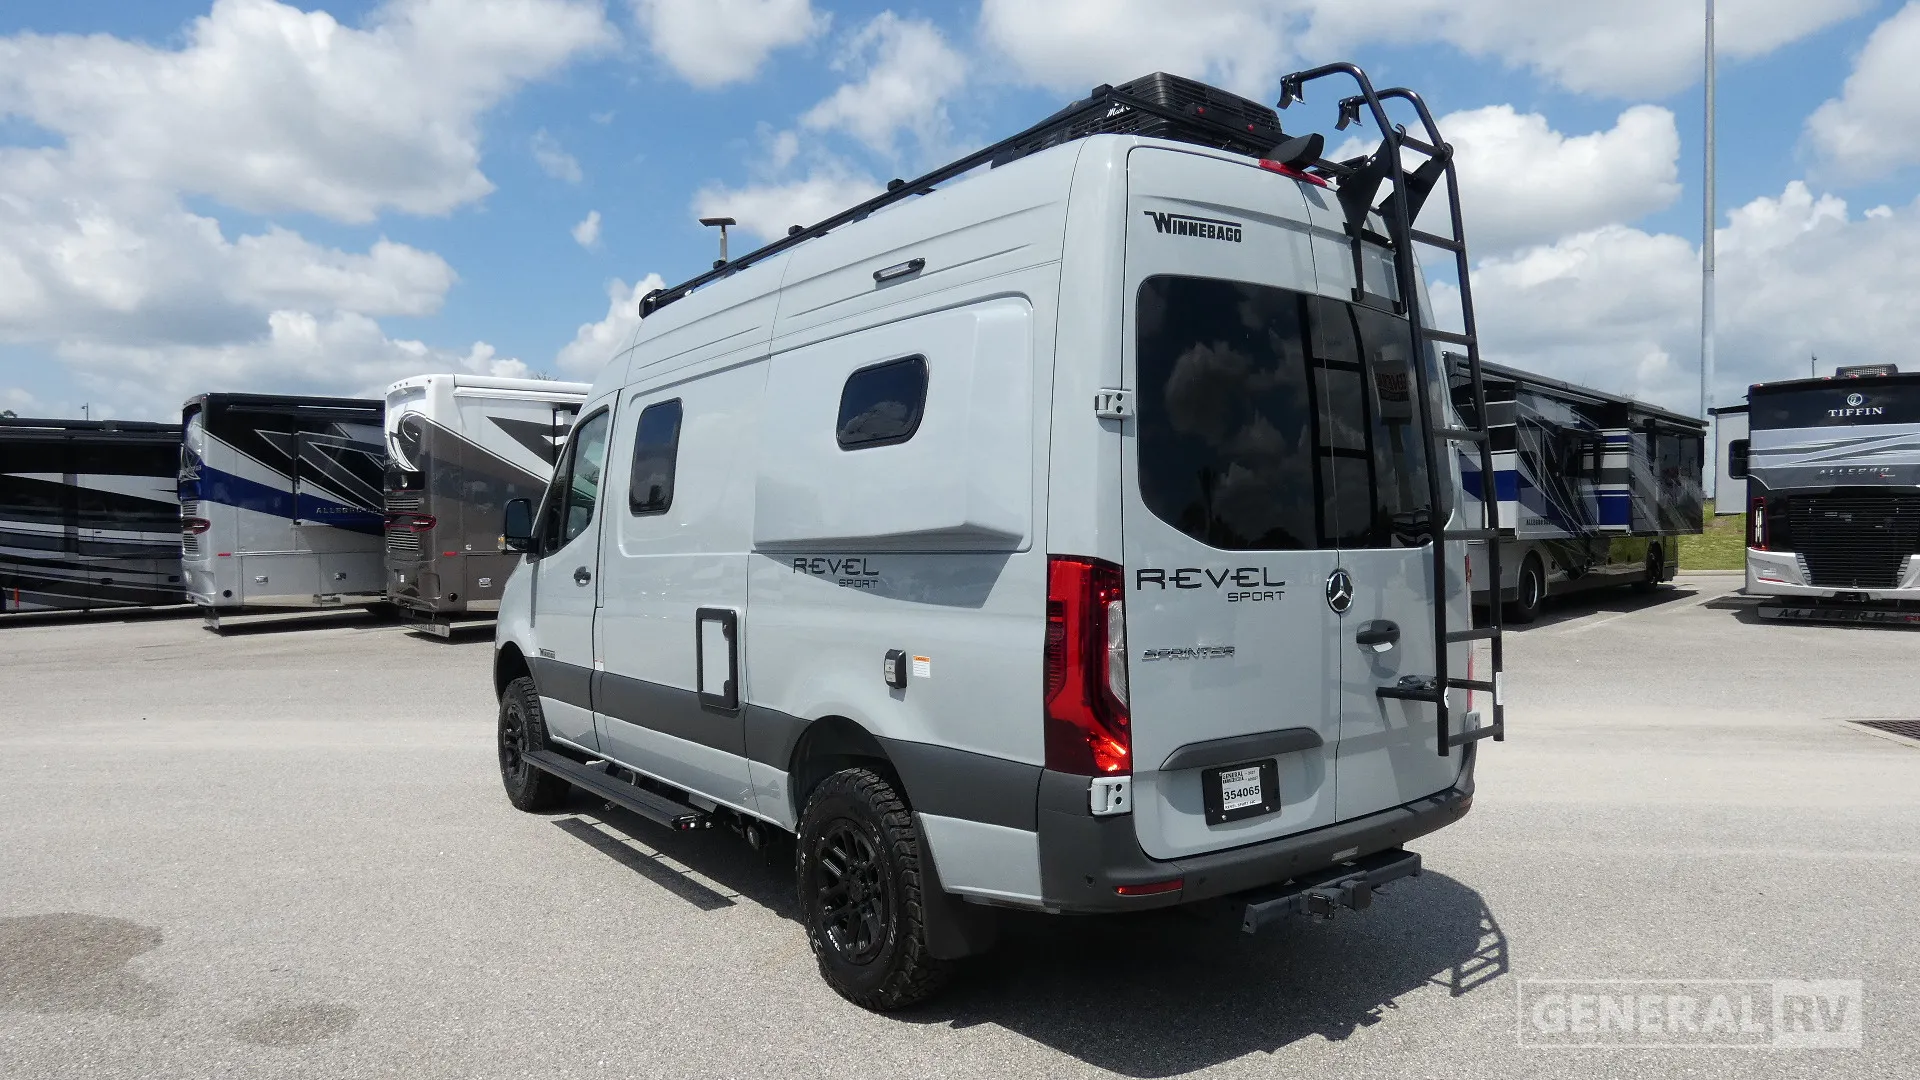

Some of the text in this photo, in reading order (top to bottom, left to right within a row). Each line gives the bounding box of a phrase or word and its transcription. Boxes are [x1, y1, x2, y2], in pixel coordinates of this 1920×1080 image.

[1143, 210, 1242, 243] WINNEBAGO
[1828, 406, 1883, 417] TIFFIN
[793, 557, 879, 576] REVEL
[838, 578, 879, 589] SPORT
[1136, 566, 1286, 591] REVEL
[1227, 590, 1286, 603] SPORT
[1141, 646, 1236, 662] SPRINTER
[1224, 785, 1260, 801] 354065
